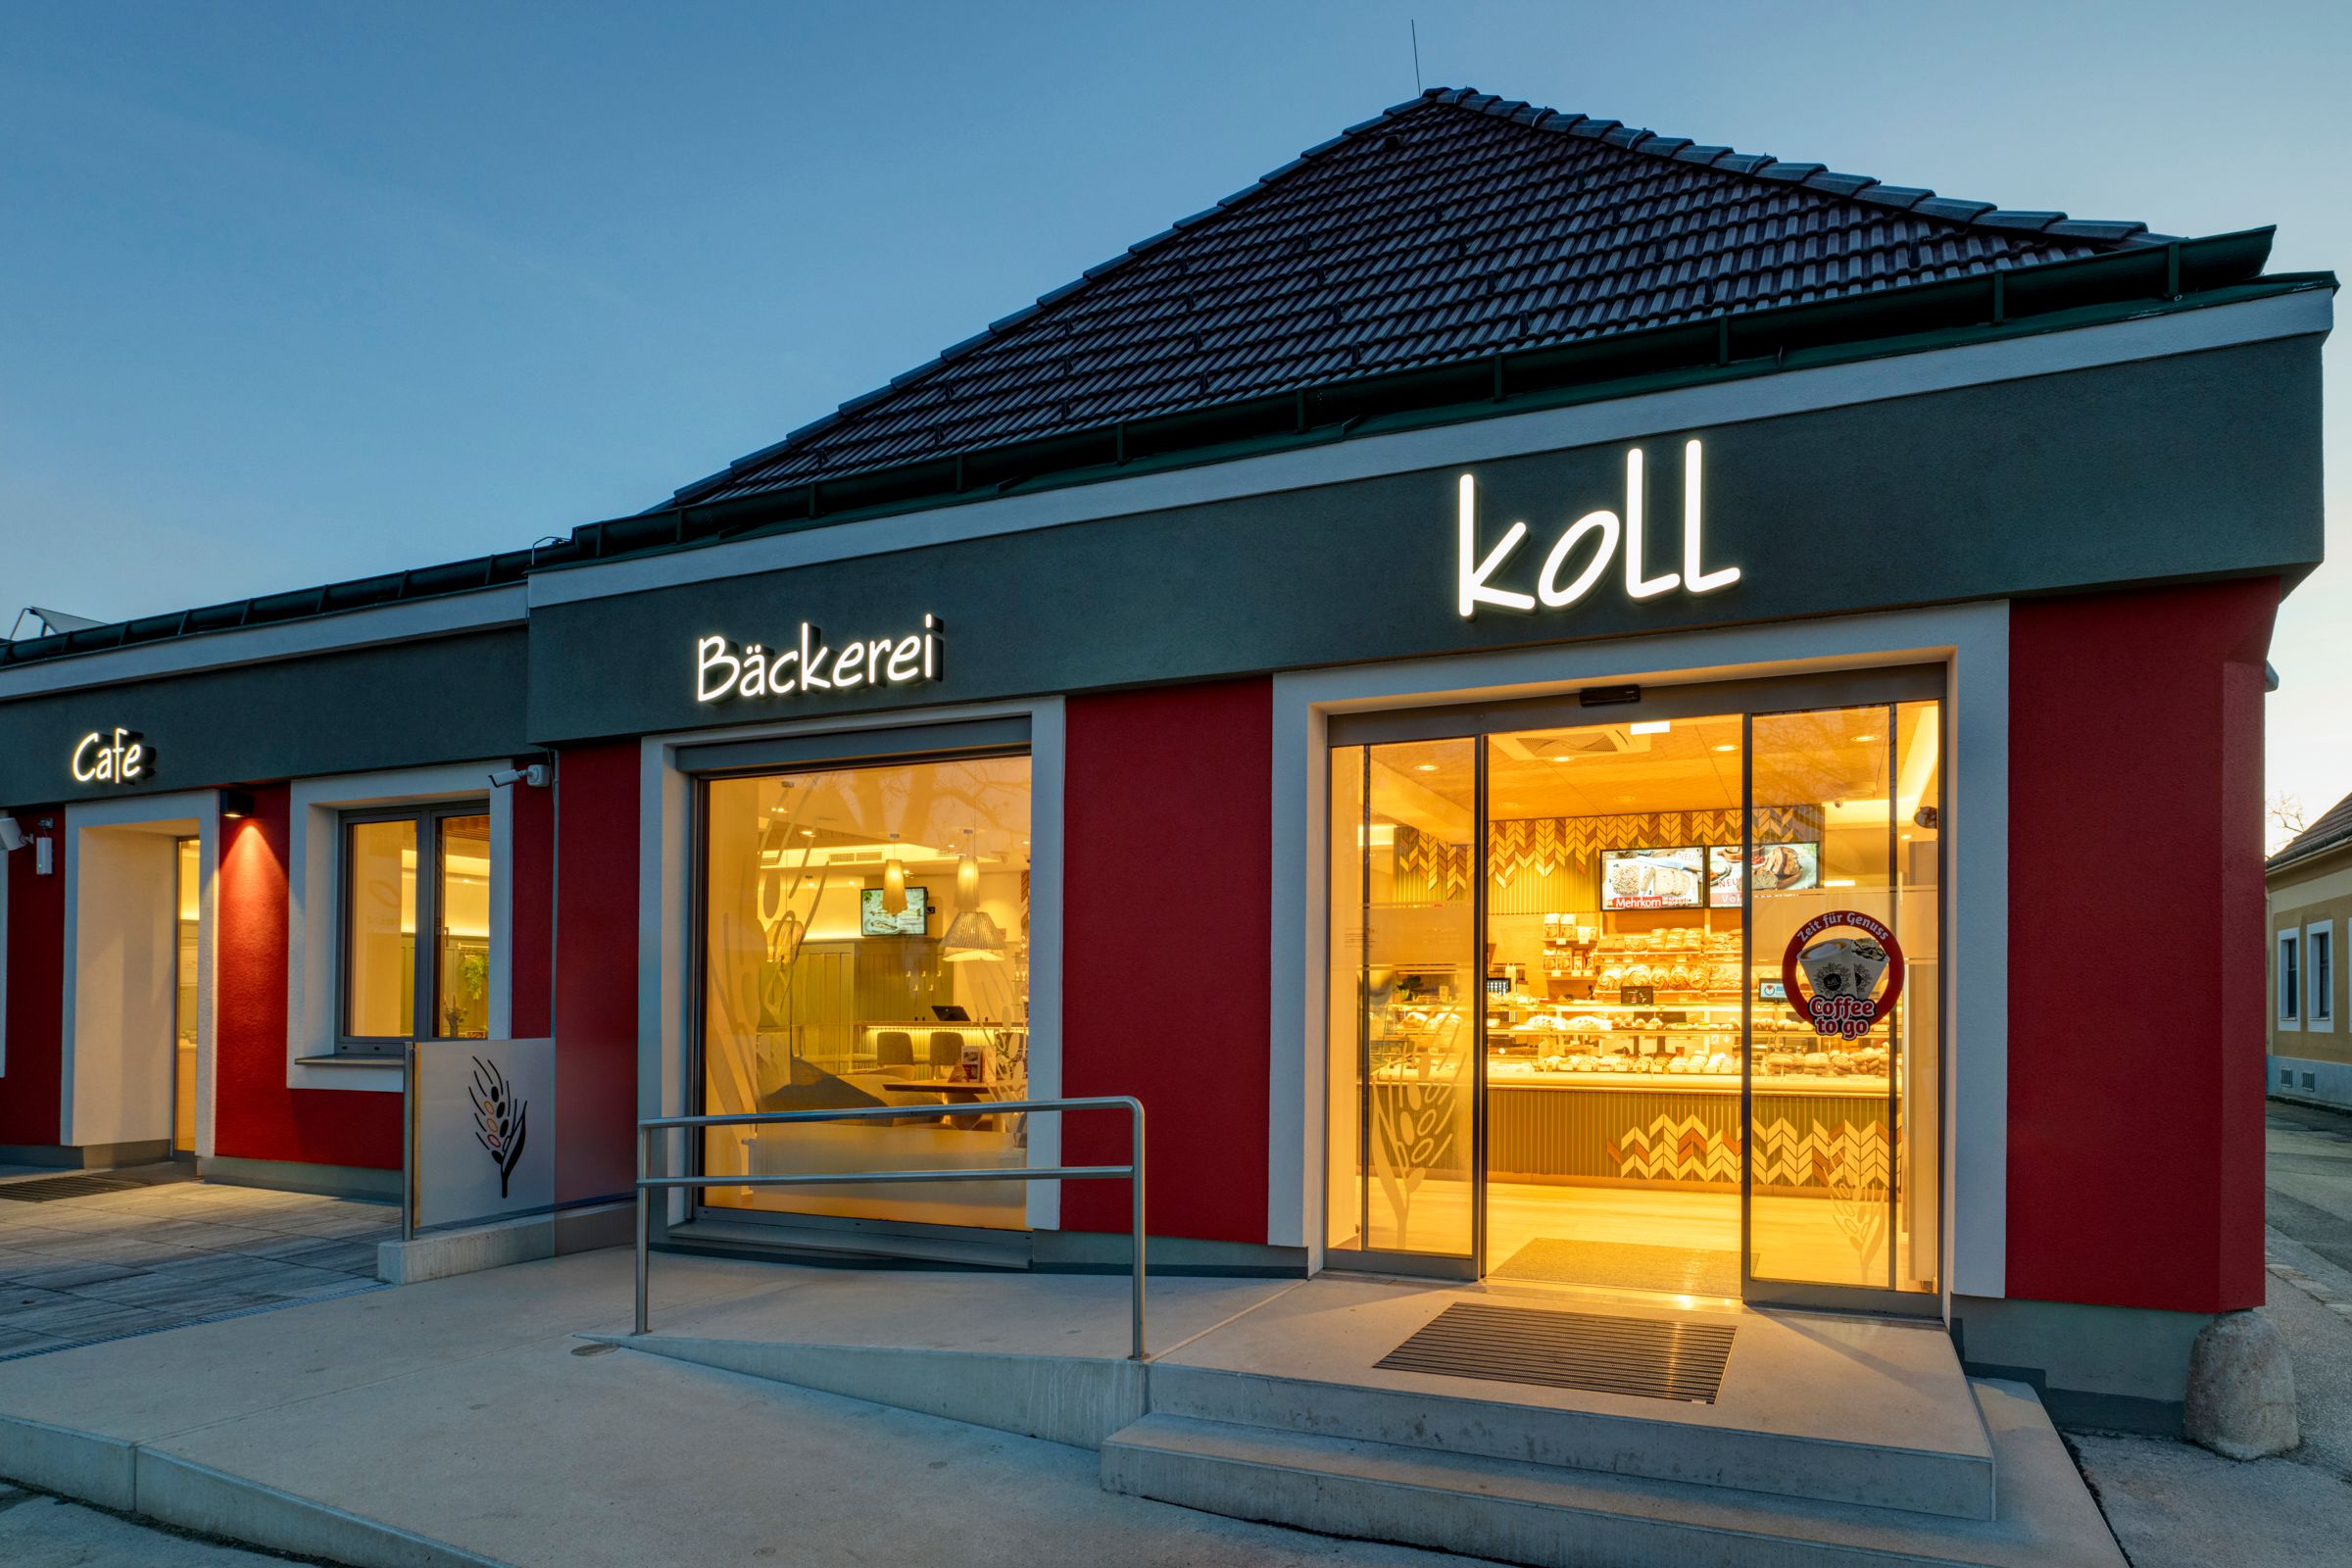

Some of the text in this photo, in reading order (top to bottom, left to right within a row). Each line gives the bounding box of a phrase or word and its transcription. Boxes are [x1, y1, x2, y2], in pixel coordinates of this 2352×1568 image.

[697, 612, 932, 703] Bäckerei
[72, 727, 142, 784] Cafe
[1677, 852, 1695, 861] NEU
[1719, 877, 1740, 888] NEU
[1797, 912, 1888, 942] Zeit für Genuss
[1810, 996, 1875, 1021] Coffee
[1814, 1016, 1869, 1040] to go
